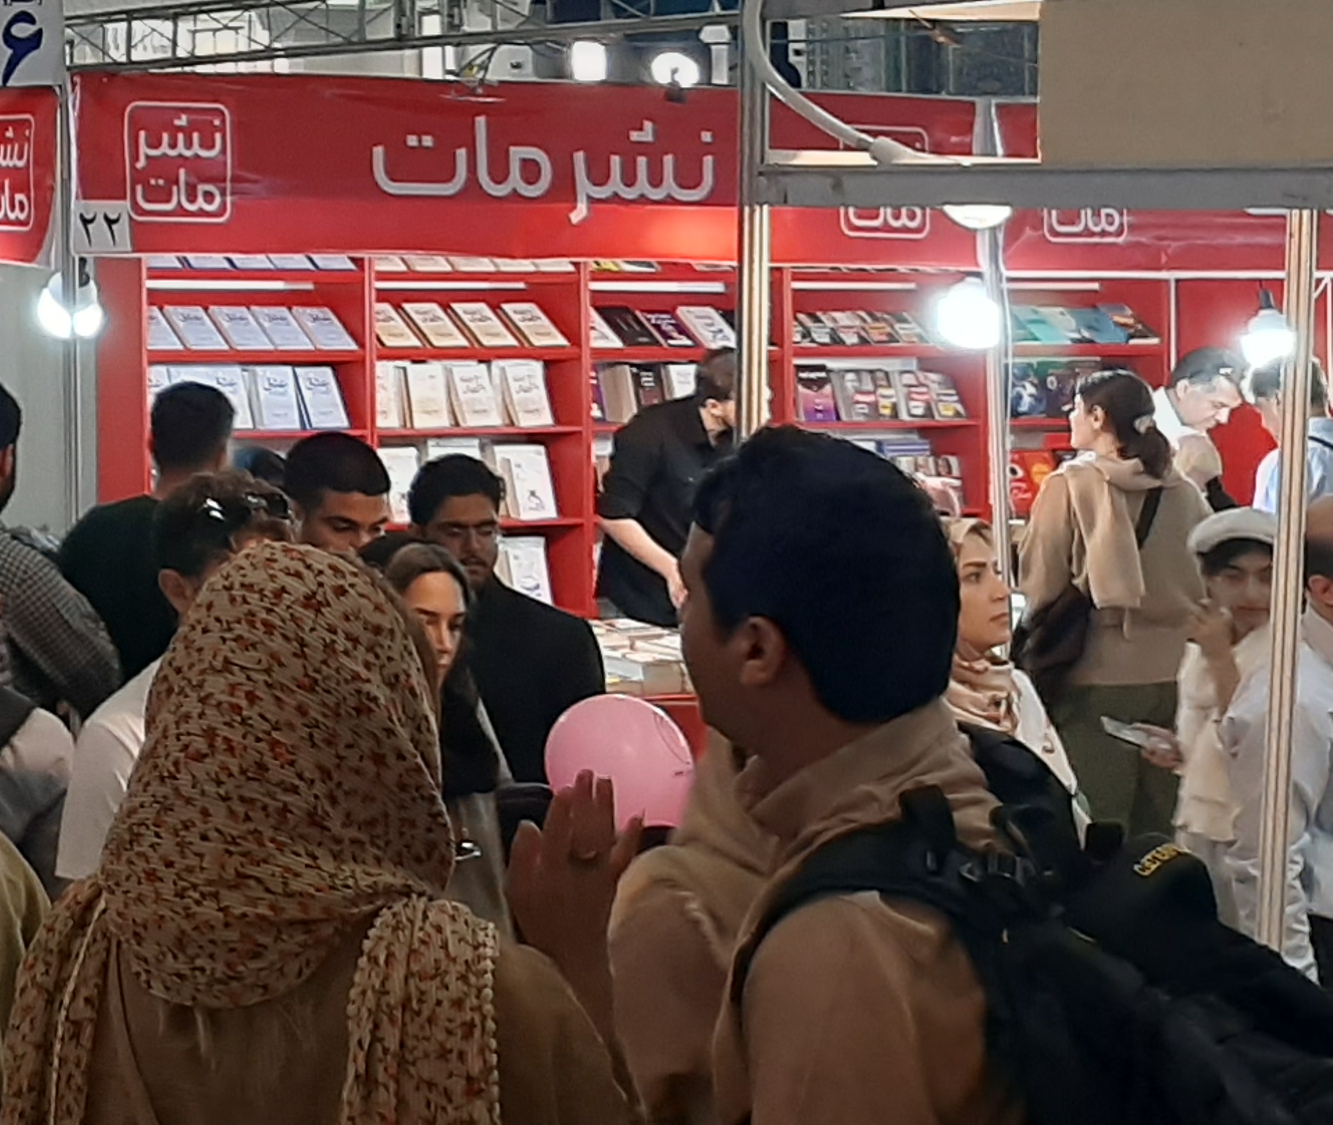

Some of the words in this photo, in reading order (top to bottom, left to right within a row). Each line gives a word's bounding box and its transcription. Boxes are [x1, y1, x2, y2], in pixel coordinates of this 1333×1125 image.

[135, 114, 222, 170] نشر
[372, 115, 552, 198] مات
[135, 168, 222, 212] مات
[569, 119, 715, 225] نشر
[79, 211, 122, 248] ۲۲
